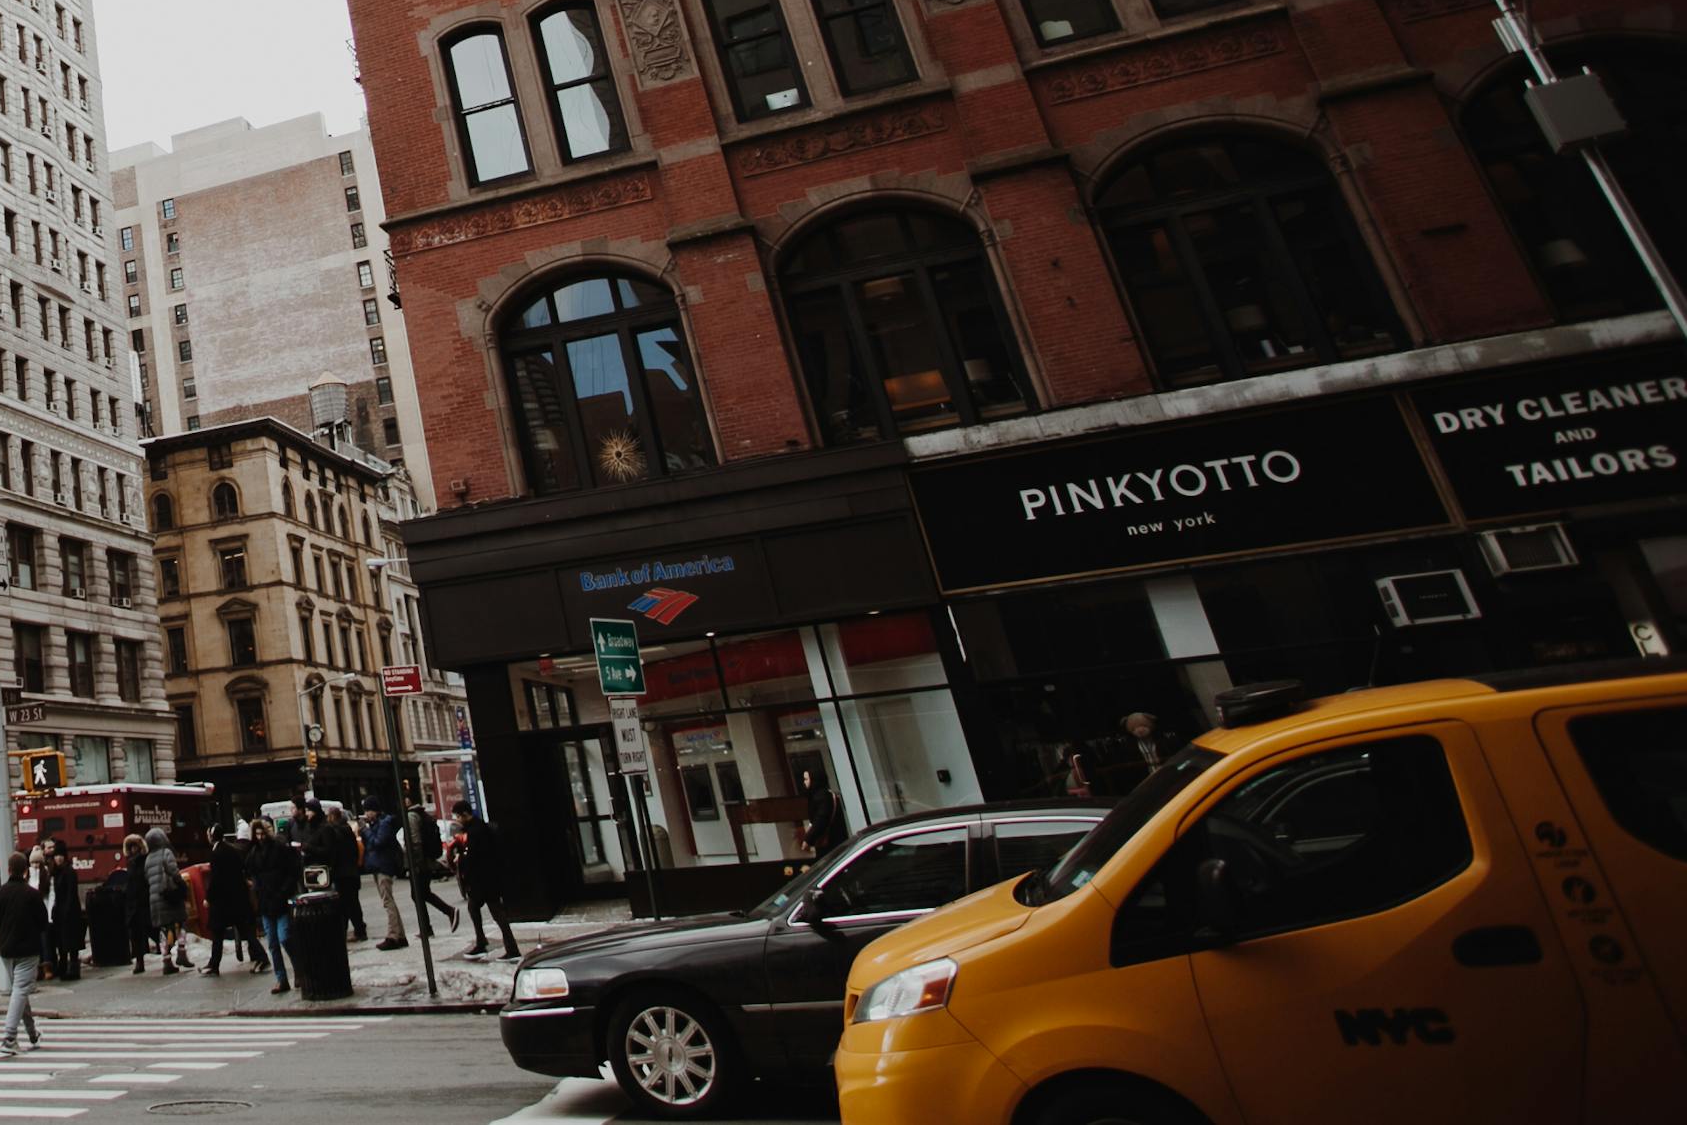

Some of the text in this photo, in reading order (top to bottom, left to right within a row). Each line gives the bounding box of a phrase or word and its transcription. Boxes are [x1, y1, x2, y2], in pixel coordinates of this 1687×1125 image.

[1433, 403, 1505, 434] DRY
[1554, 426, 1597, 444] AND
[1505, 445, 1677, 487] TAILORS
[1019, 450, 1301, 521] PINKYOTTO
[1127, 511, 1216, 536] new york
[580, 555, 735, 592] Bank of America
[9, 706, 43, 723] W 23 St
[133, 804, 172, 824] Dunbar
[1334, 1007, 1456, 1045] NYC
